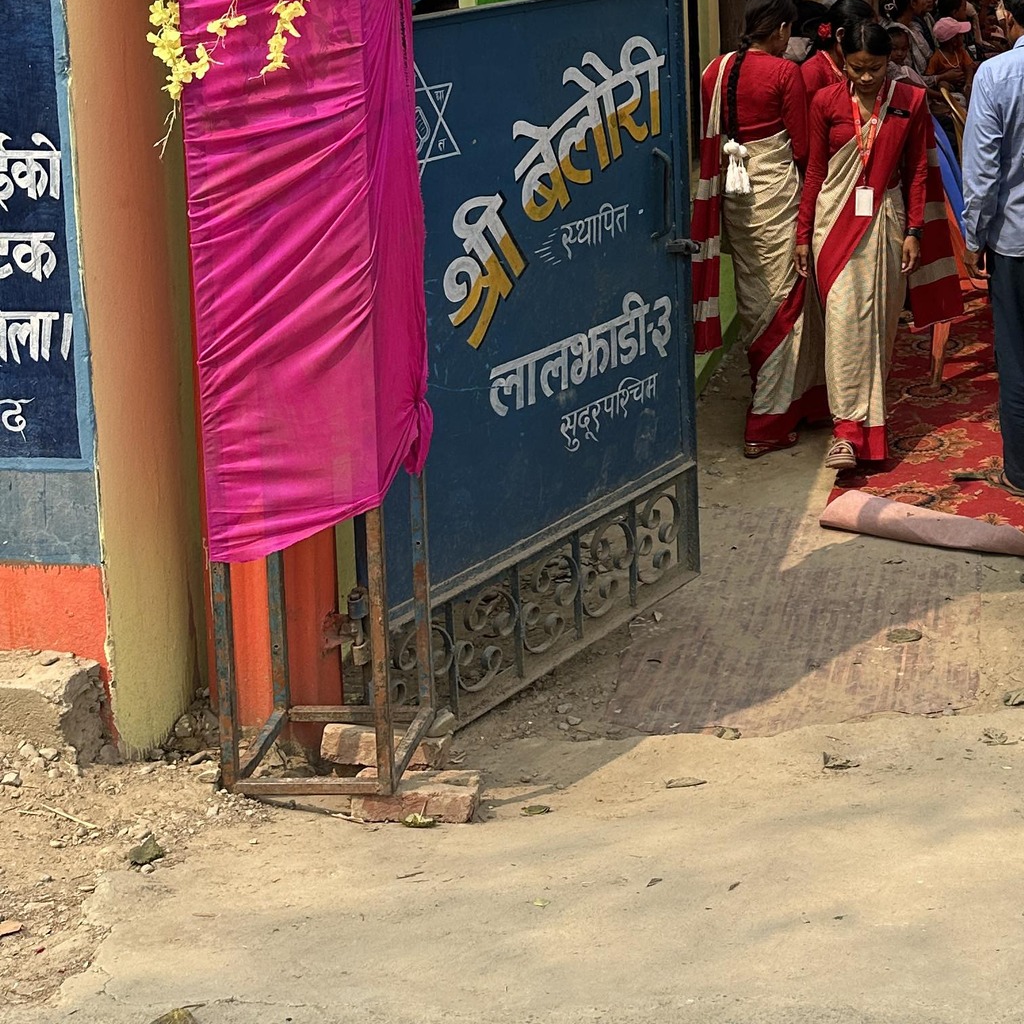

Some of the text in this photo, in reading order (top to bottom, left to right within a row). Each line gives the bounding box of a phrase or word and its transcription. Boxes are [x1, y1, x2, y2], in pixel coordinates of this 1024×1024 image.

[443, 35, 667, 350] श्री बेलौरी
[561, 203, 629, 261] स्थापित
[560, 372, 659, 453] सुदूरपश्चिम
